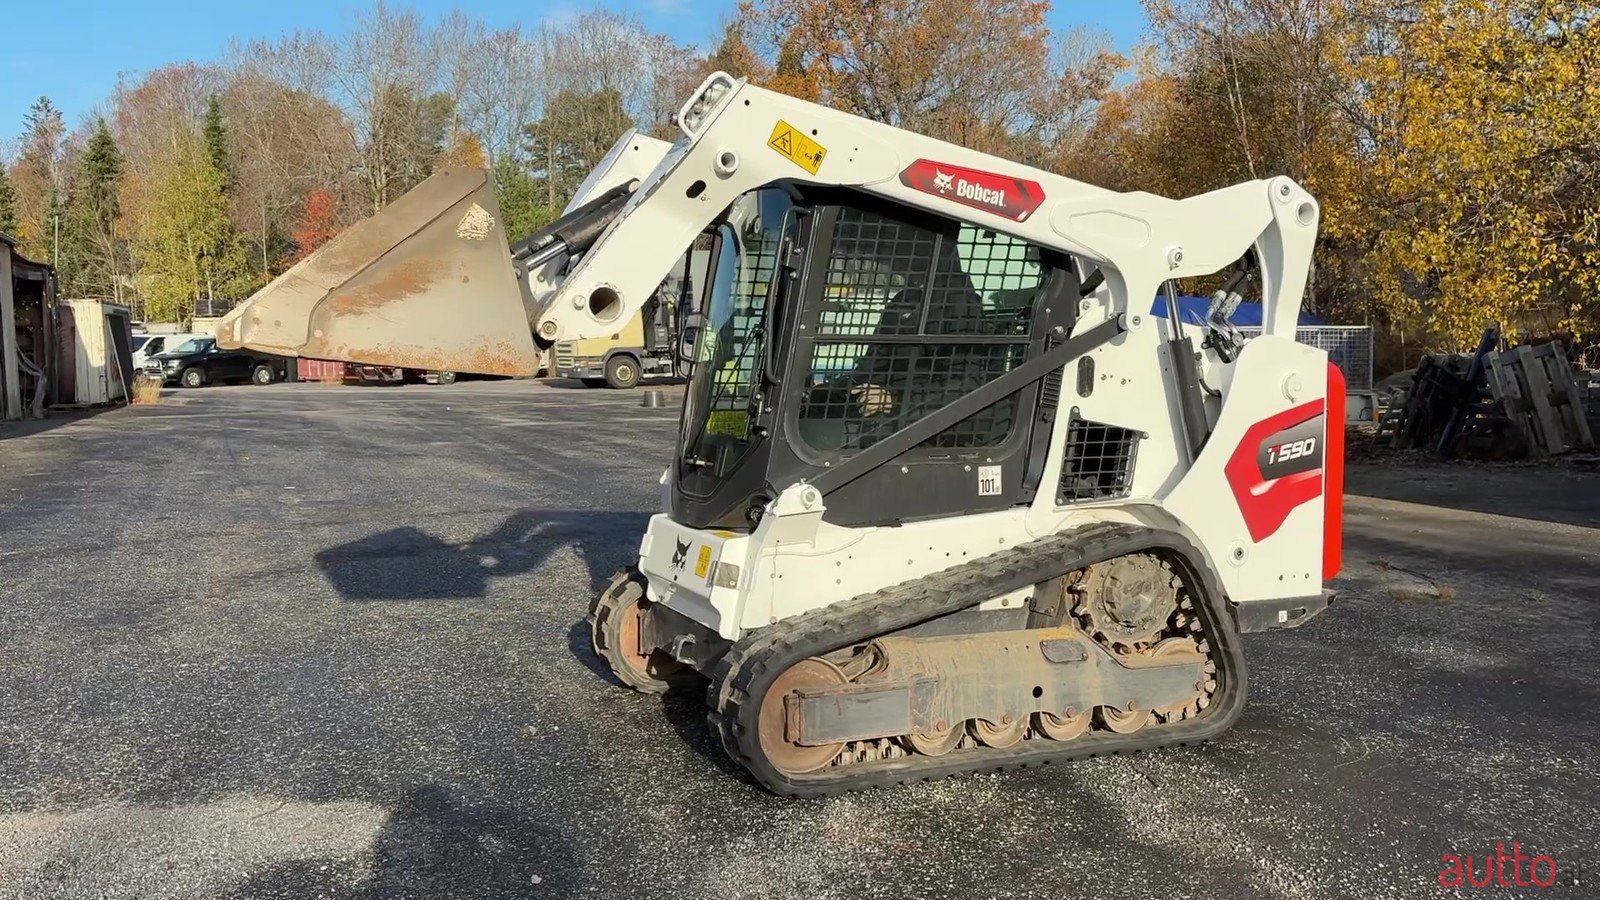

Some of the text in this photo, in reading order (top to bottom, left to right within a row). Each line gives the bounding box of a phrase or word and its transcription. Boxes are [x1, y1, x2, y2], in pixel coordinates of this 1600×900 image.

[956, 178, 1006, 207] Bobcat
[1267, 437, 1316, 465] T590
[980, 478, 995, 493] 101
